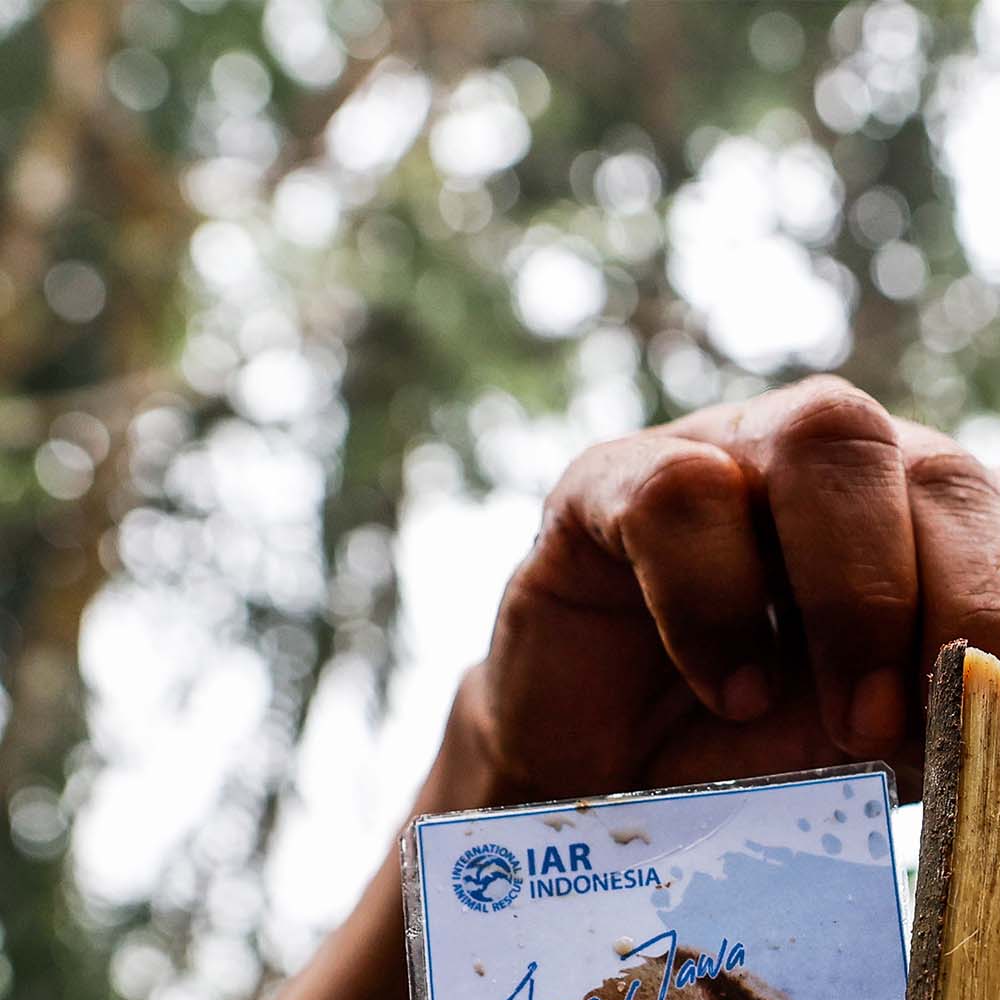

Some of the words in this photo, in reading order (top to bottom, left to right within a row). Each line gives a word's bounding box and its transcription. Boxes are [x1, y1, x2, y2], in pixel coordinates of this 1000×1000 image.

[452, 843, 523, 880] INTERNATIONAL
[527, 843, 593, 876] IAR
[452, 882, 489, 914] ANIMAL
[492, 878, 523, 913] RESCUE
[530, 867, 662, 899] INDONESIA
